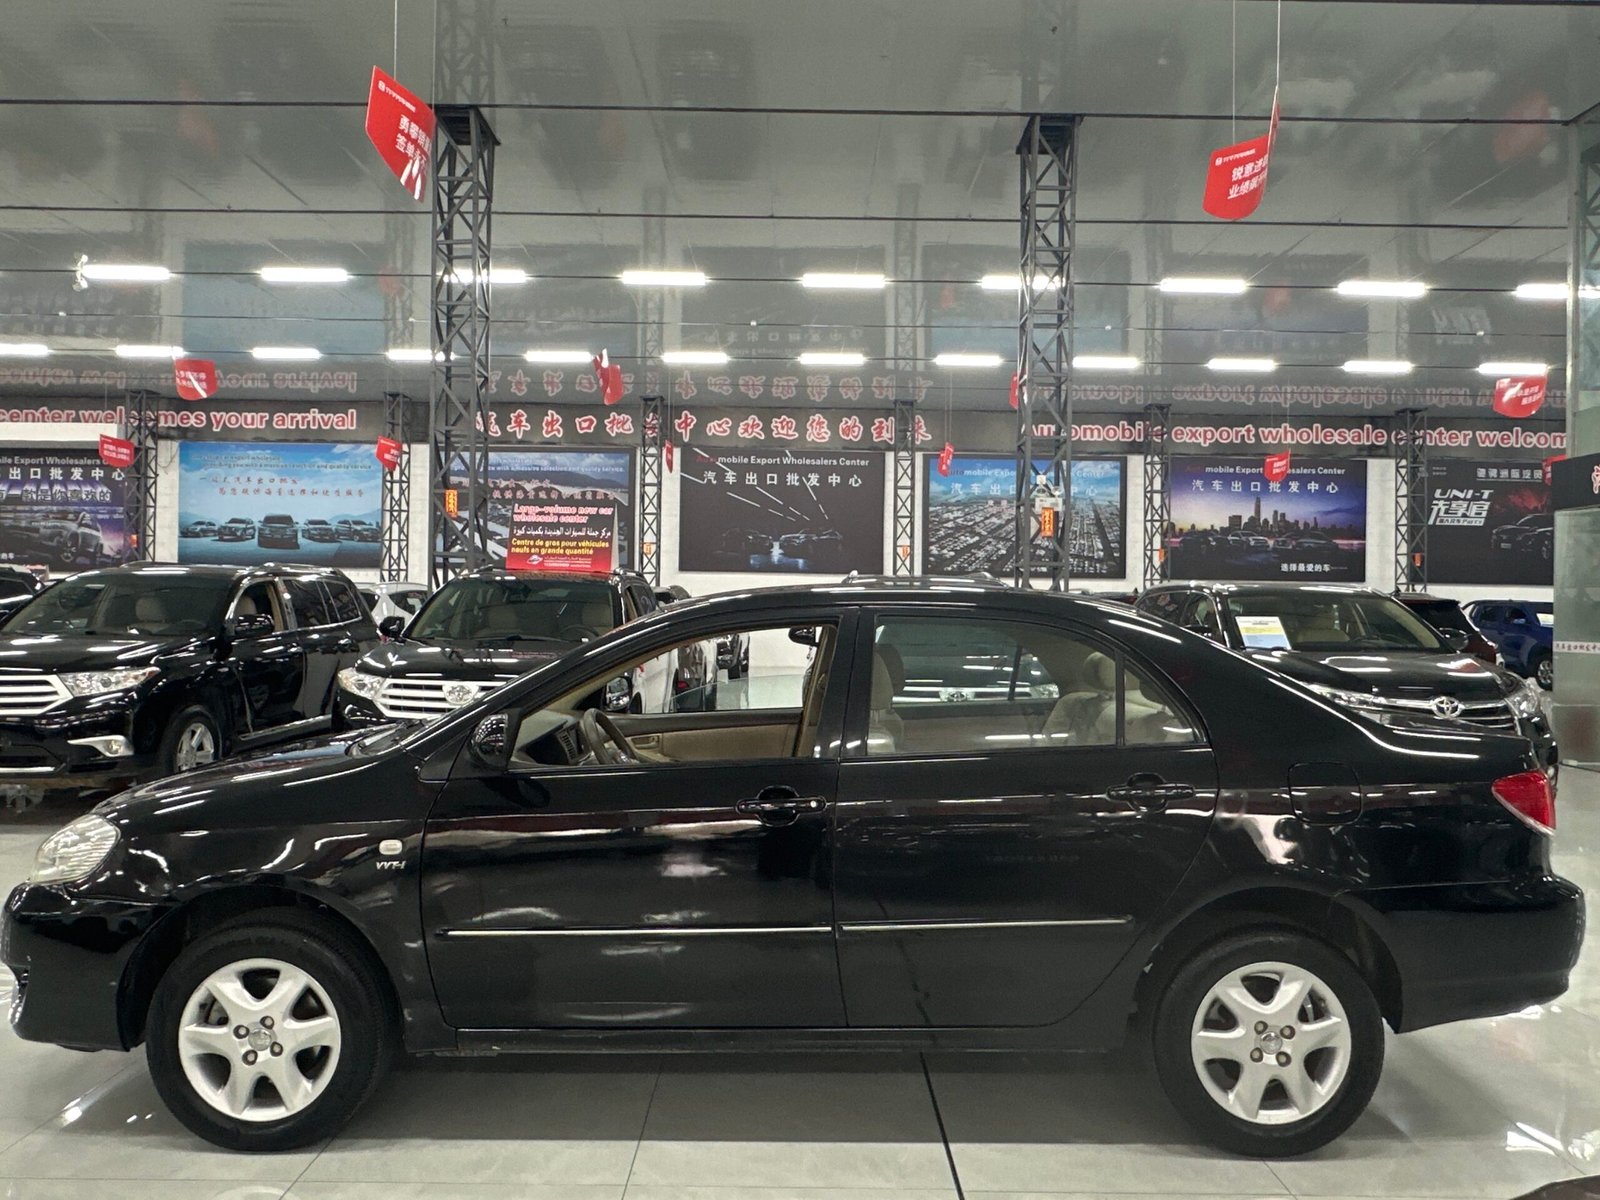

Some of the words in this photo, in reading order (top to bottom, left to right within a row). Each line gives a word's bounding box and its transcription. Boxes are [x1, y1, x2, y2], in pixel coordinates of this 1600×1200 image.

[209, 408, 268, 431] your
[272, 407, 357, 429] arrival
[1171, 424, 1255, 447] export
[1259, 422, 1388, 446] wholesale
[14, 456, 43, 465] Export
[45, 456, 100, 465] Wholesalers
[751, 456, 781, 466] Export
[782, 456, 838, 466] Wholesalers
[839, 457, 870, 467] Center
[1236, 466, 1263, 476] Export
[1317, 467, 1346, 475] Center
[703, 470, 862, 487] 汽车出口批发中心
[1191, 479, 1338, 493] 汽车出口批发中心
[1433, 488, 1495, 500] UNI-T
[577, 506, 598, 515] new
[598, 507, 614, 516] car
[559, 514, 589, 523] center
[511, 538, 534, 546] Centre
[545, 540, 560, 548] gros
[561, 541, 578, 549] pour
[578, 540, 609, 548] véhicules
[540, 548, 564, 556] grande
[565, 548, 594, 557] quantité
